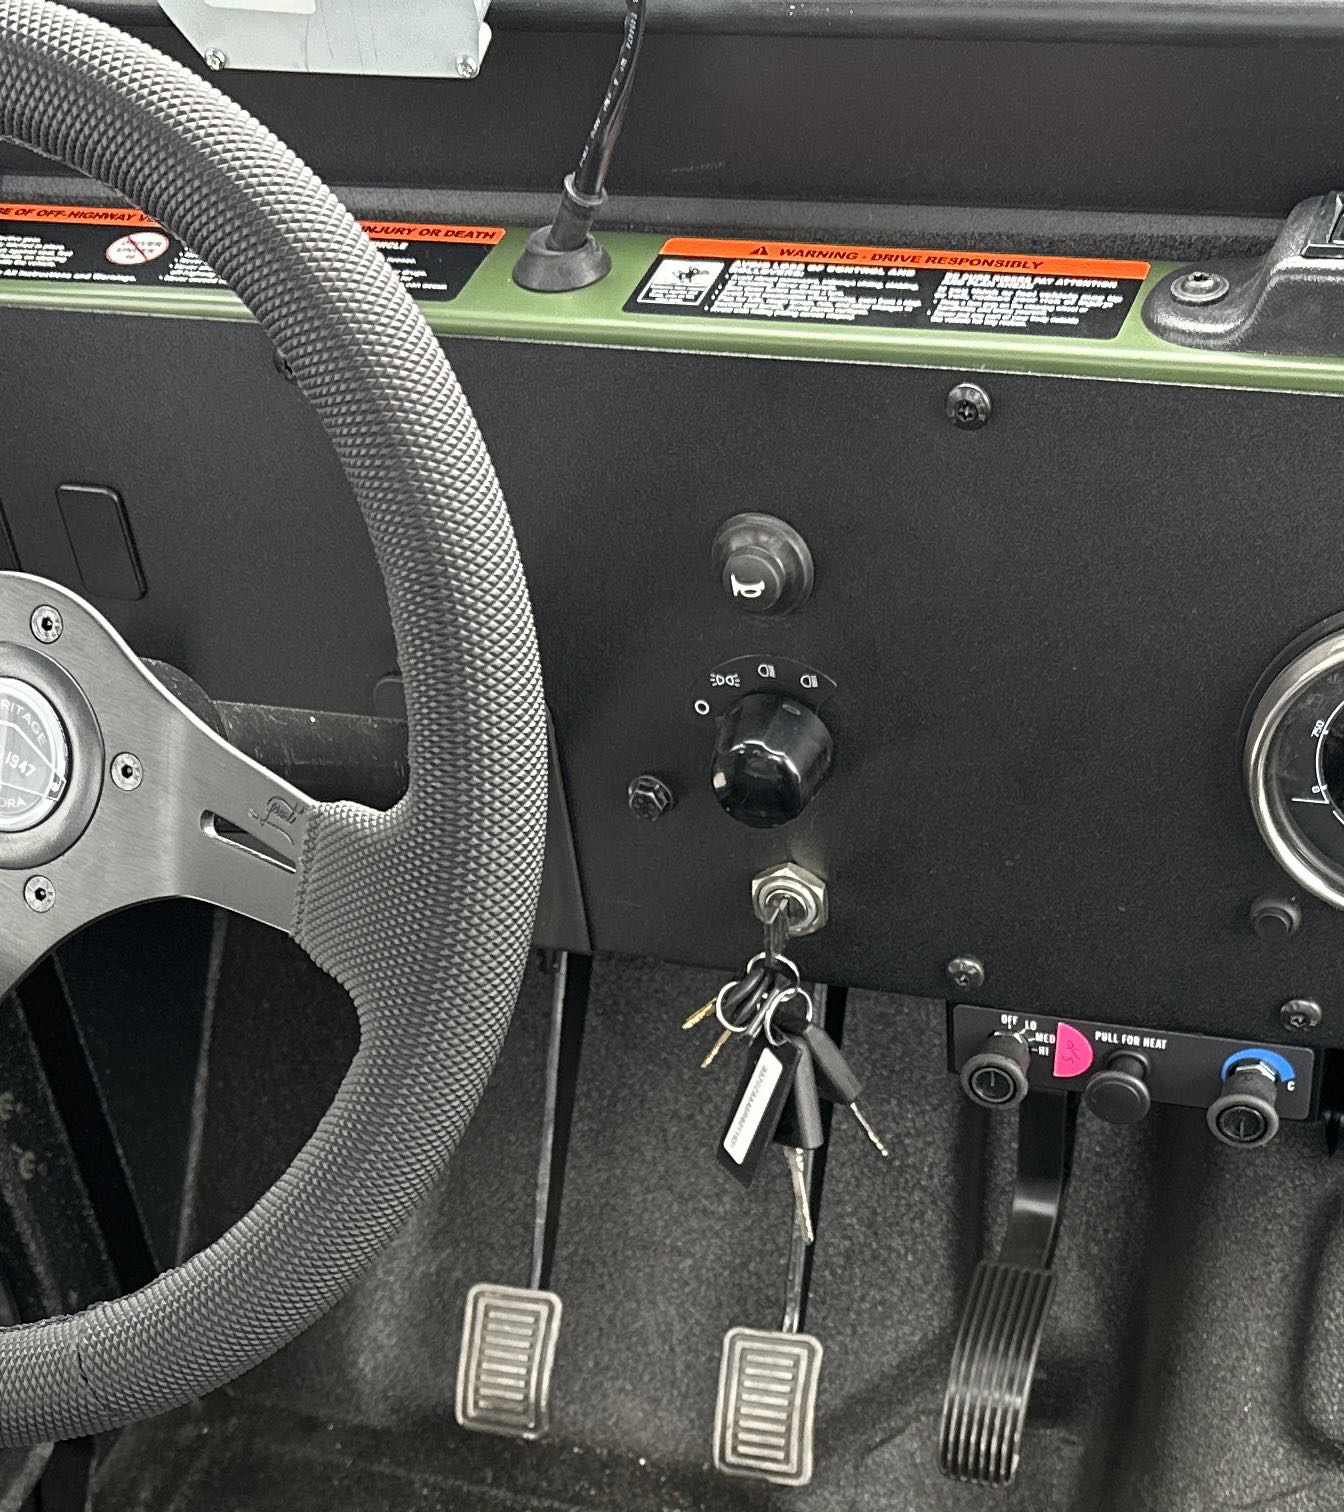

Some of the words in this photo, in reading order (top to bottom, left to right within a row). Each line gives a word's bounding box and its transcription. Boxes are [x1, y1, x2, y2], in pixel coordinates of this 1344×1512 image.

[15, 207, 37, 218] OF
[418, 228, 440, 237] OR
[443, 229, 497, 240] DEATH
[778, 248, 859, 260] WARNING
[870, 252, 922, 264] DRIVE
[924, 254, 1045, 271] RESPONSIBLY
[1310, 719, 1326, 739] 750
[5, 750, 36, 777] 1947
[1000, 1013, 1019, 1026] OFF
[1024, 1020, 1038, 1030] LO
[1034, 1032, 1056, 1044] MED
[1094, 1030, 1120, 1046] PULL
[1121, 1034, 1141, 1047] FOR
[1143, 1037, 1168, 1050] HEAT
[1038, 1045, 1050, 1056] HI
[1287, 1080, 1296, 1092] C
